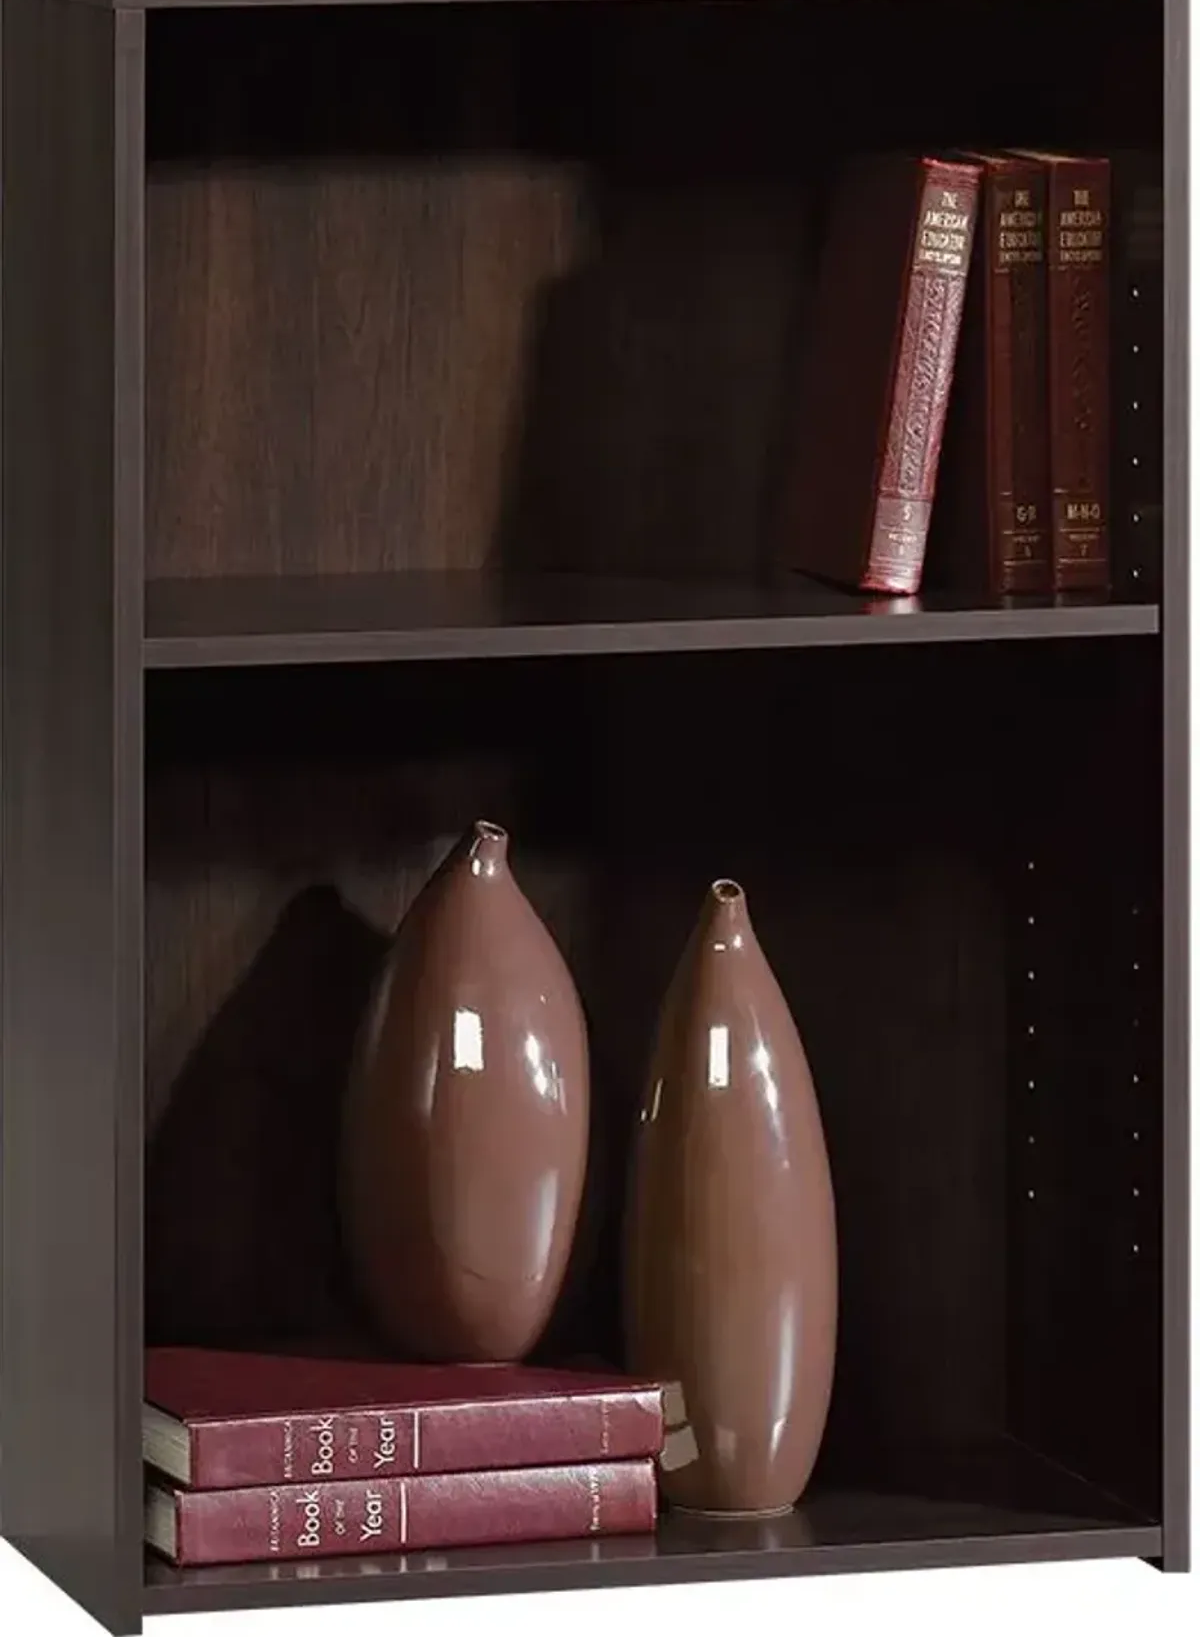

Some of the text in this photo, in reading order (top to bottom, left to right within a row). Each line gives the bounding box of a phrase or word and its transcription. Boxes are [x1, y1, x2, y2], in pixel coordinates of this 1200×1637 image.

[310, 1415, 334, 1475] Book
[373, 1417, 396, 1469] Year
[295, 1489, 321, 1547] Book
[360, 1489, 382, 1542] Year
